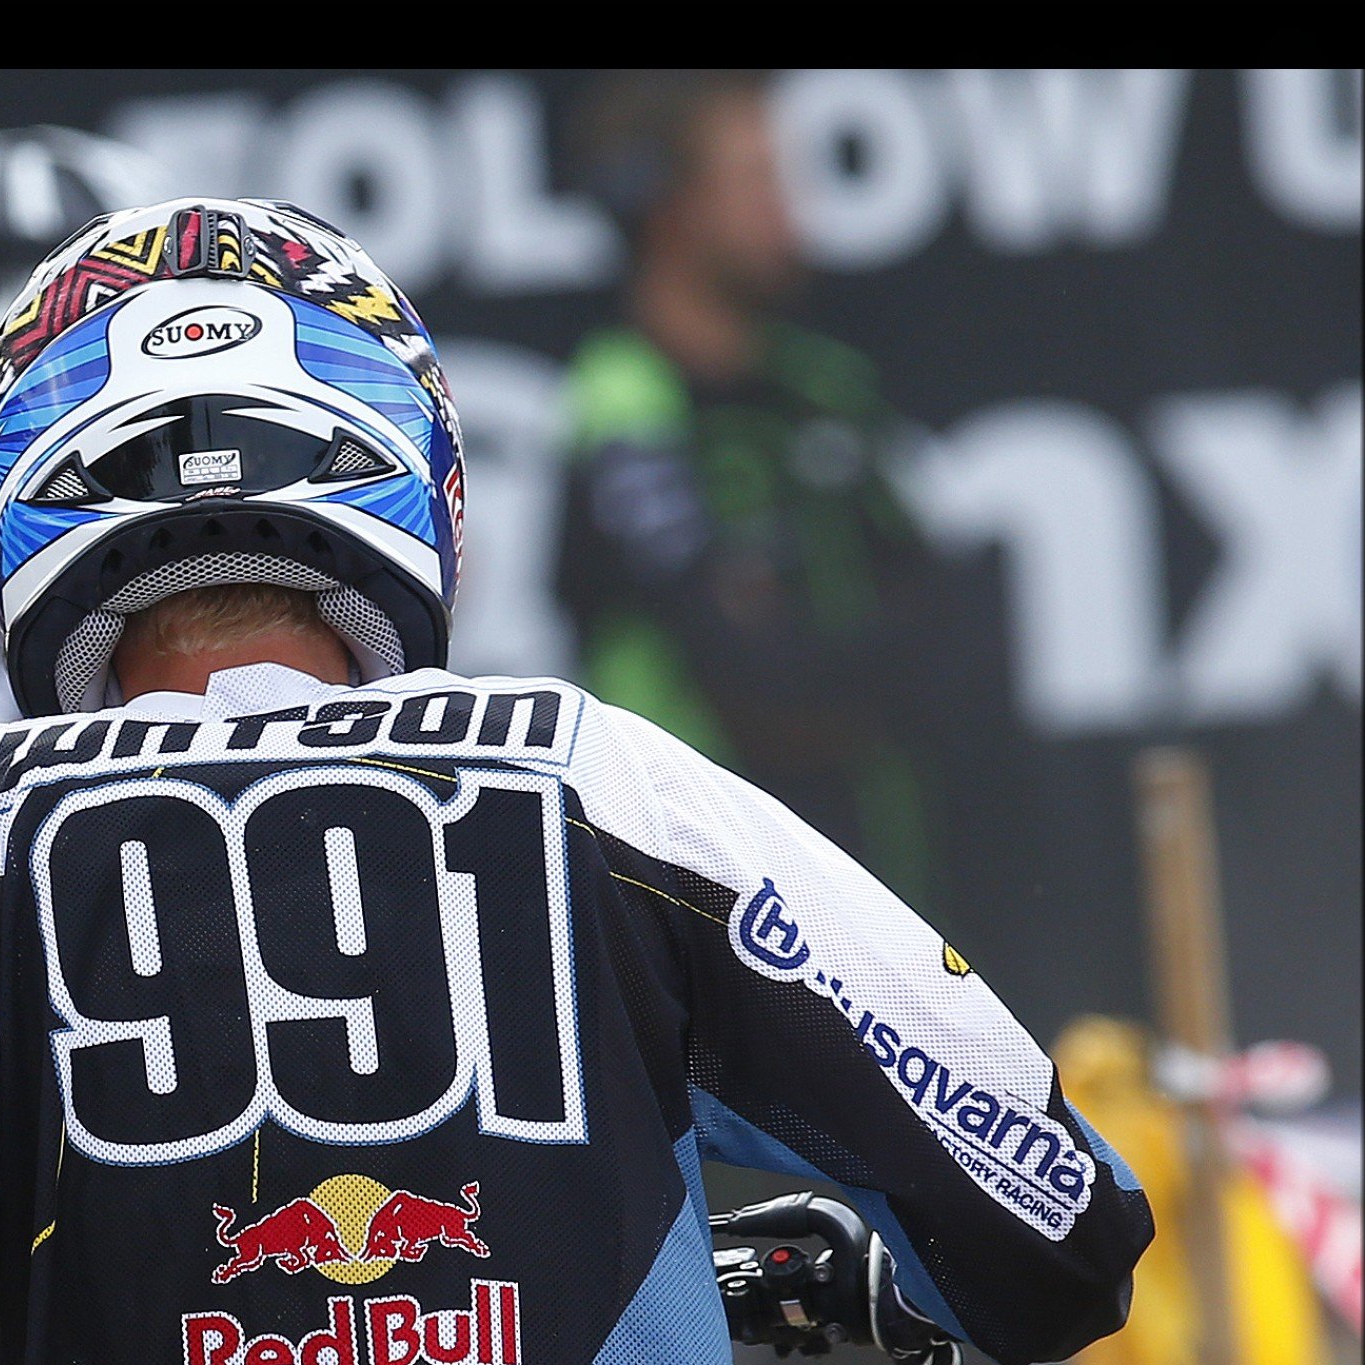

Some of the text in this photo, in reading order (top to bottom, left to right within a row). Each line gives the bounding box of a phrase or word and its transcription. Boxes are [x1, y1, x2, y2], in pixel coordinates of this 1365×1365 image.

[151, 323, 252, 347] SUOMY
[186, 454, 233, 468] SUOMY
[45, 780, 569, 1148] 991
[816, 970, 1086, 1201] sqvarna
[931, 1129, 1063, 1230] CTORY RACING
